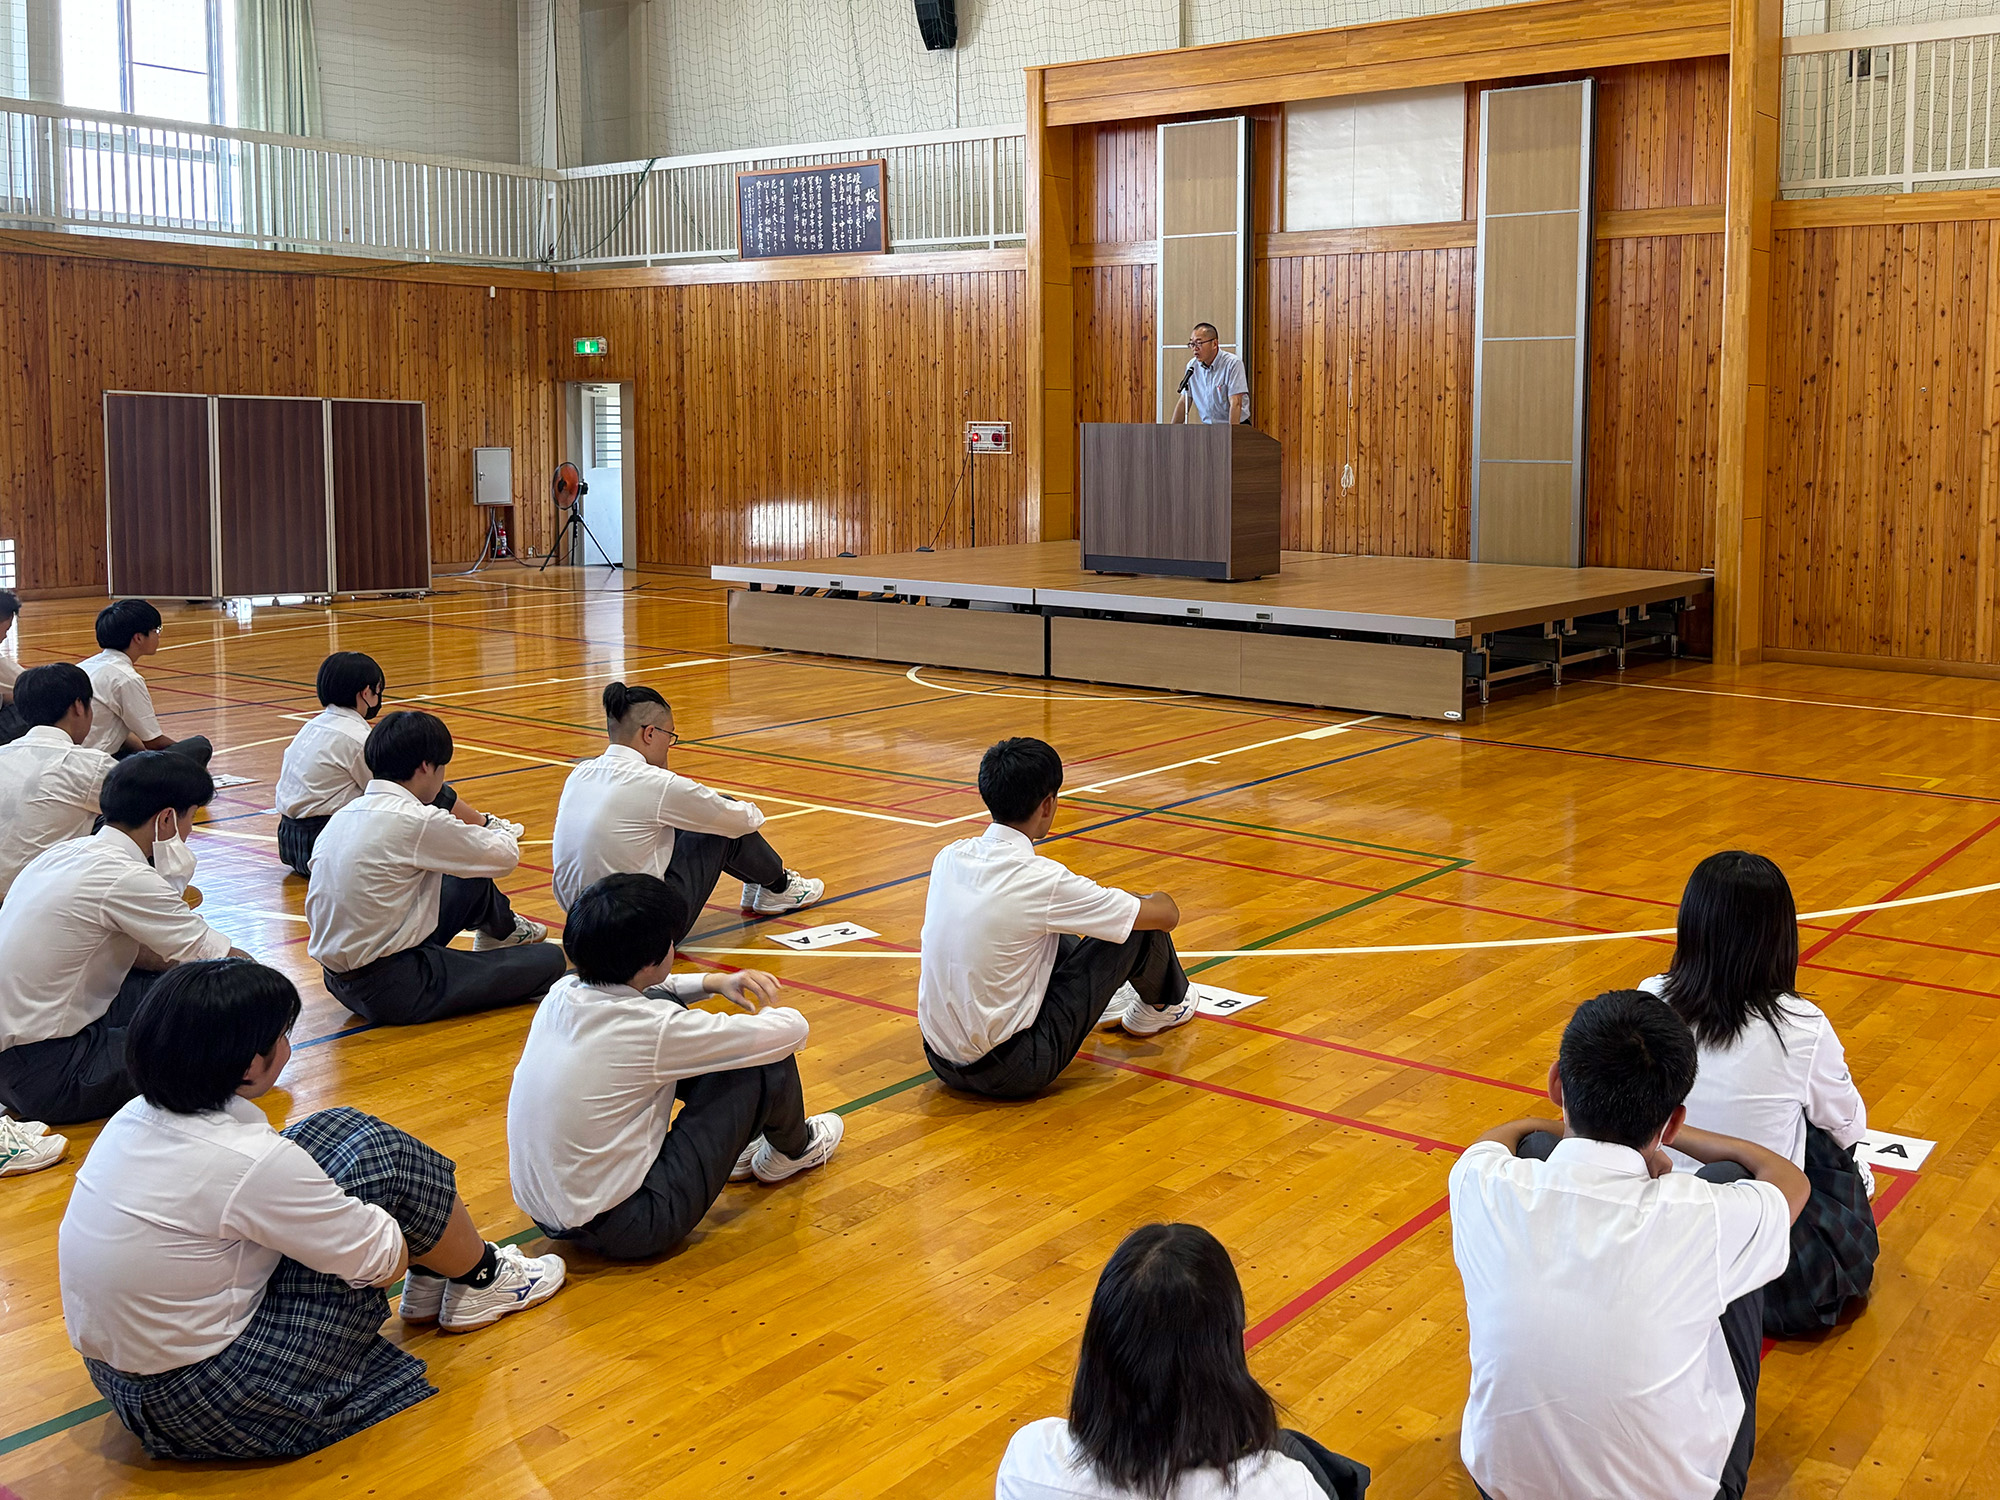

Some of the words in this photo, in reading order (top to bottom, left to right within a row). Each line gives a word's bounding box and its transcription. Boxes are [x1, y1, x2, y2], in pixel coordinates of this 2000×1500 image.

[865, 188, 879, 222] 校歌
[787, 928, 857, 944] 2-A
[1199, 995, 1242, 1008] -B
[1856, 1141, 1909, 1158] -A
